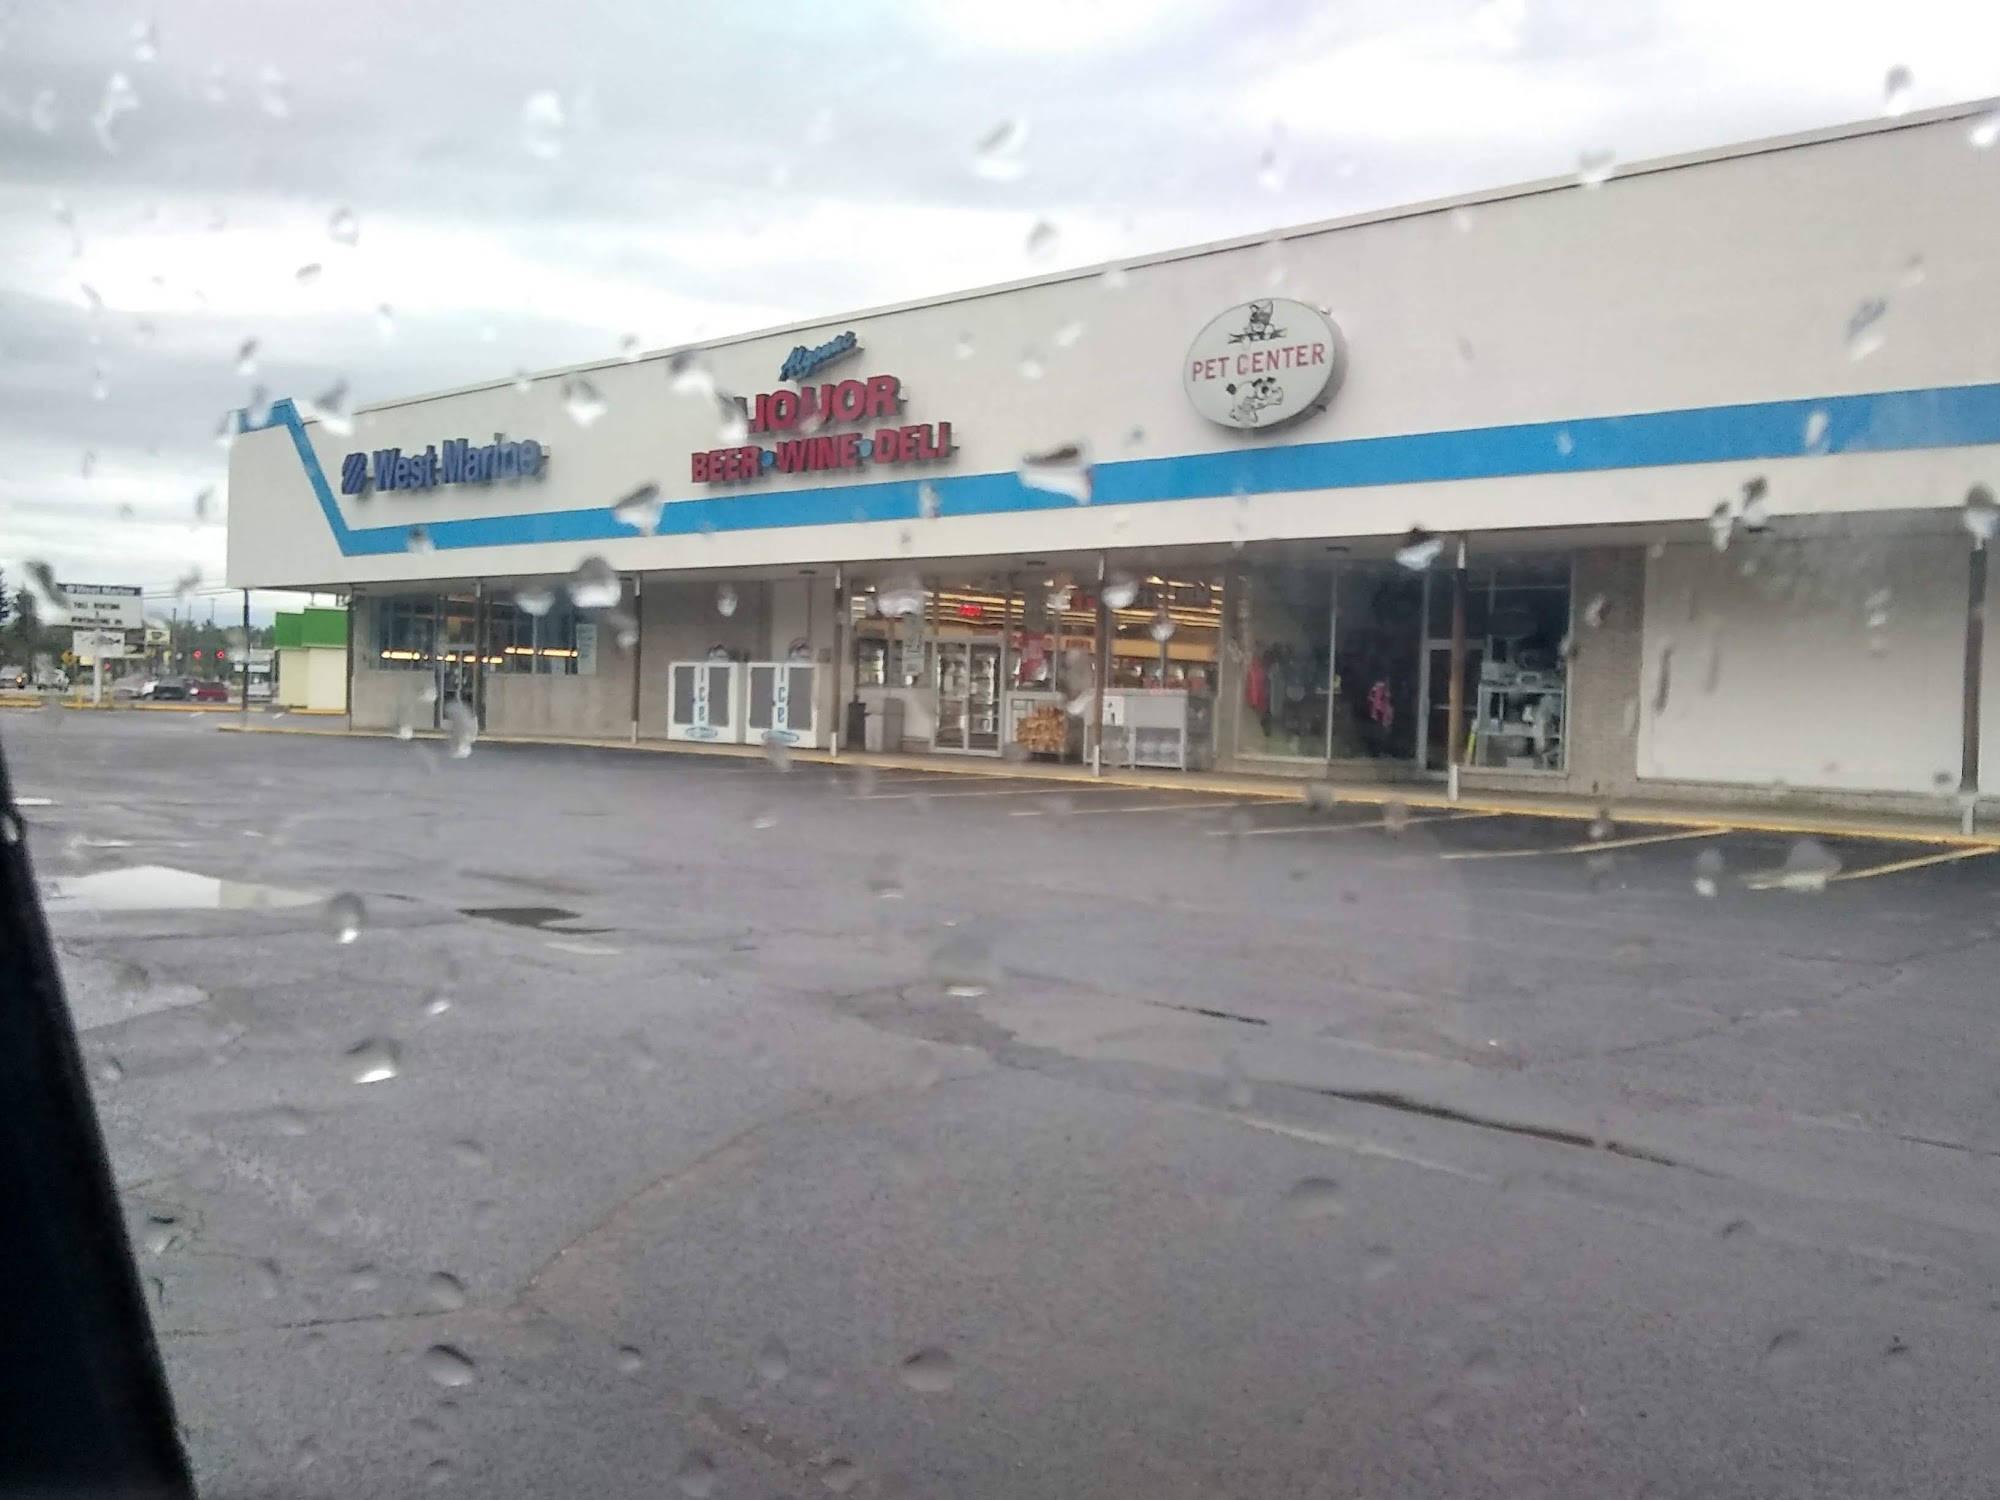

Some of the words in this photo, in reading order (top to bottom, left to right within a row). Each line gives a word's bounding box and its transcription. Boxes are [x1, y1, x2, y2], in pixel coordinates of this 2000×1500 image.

[1192, 357, 1230, 382] PET
[1236, 343, 1326, 376] CENTER
[373, 446, 437, 491] West
[441, 433, 545, 484] Marine
[691, 445, 761, 483] BEER
[777, 432, 861, 473] WINE
[874, 422, 952, 464] DELI
